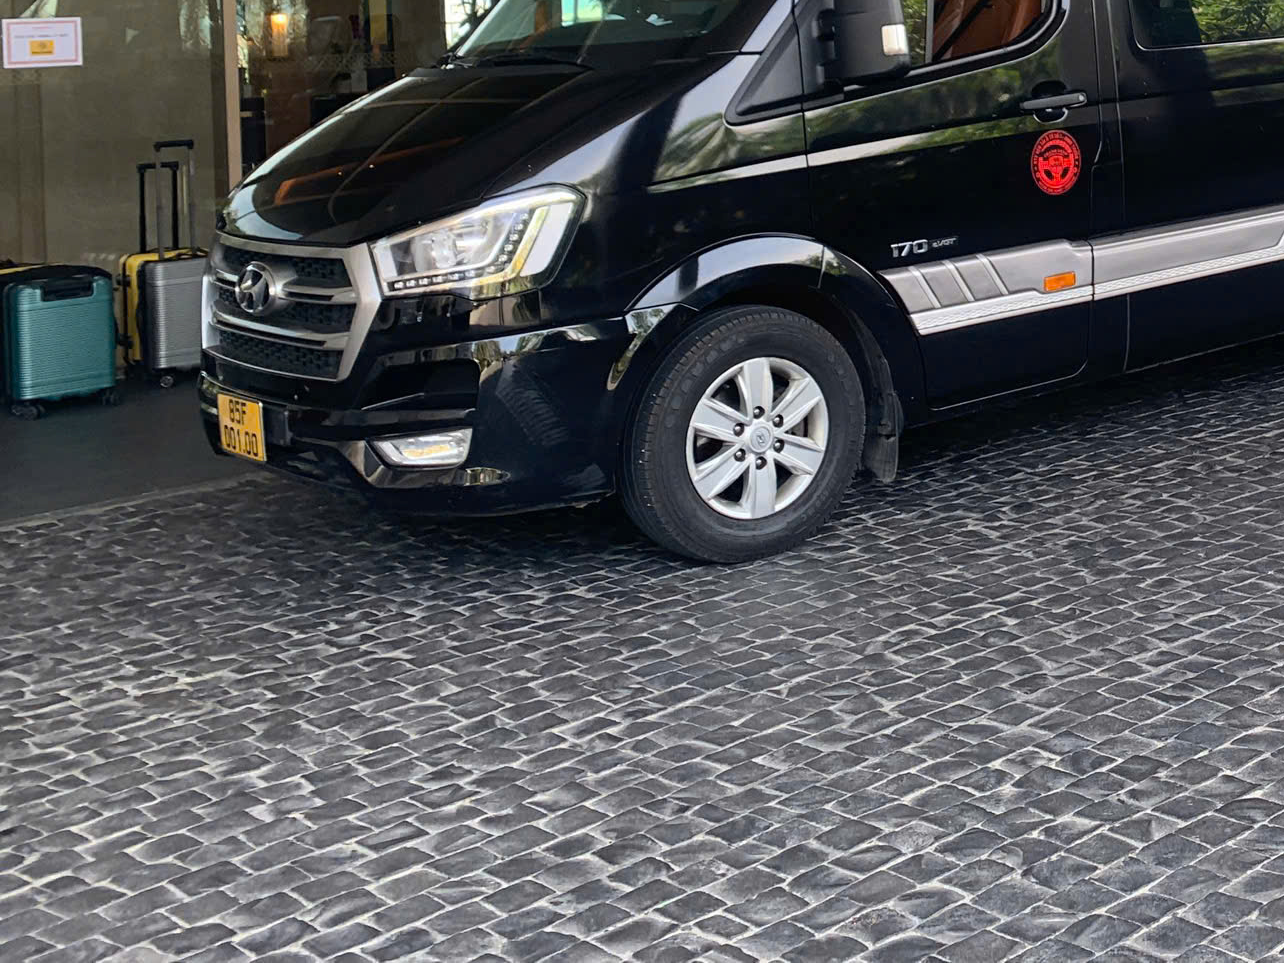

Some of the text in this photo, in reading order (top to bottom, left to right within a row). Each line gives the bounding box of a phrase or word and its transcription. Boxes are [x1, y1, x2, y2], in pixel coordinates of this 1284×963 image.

[890, 239, 928, 257] 170
[229, 398, 246, 425] 85F
[224, 424, 259, 457] 001.00
